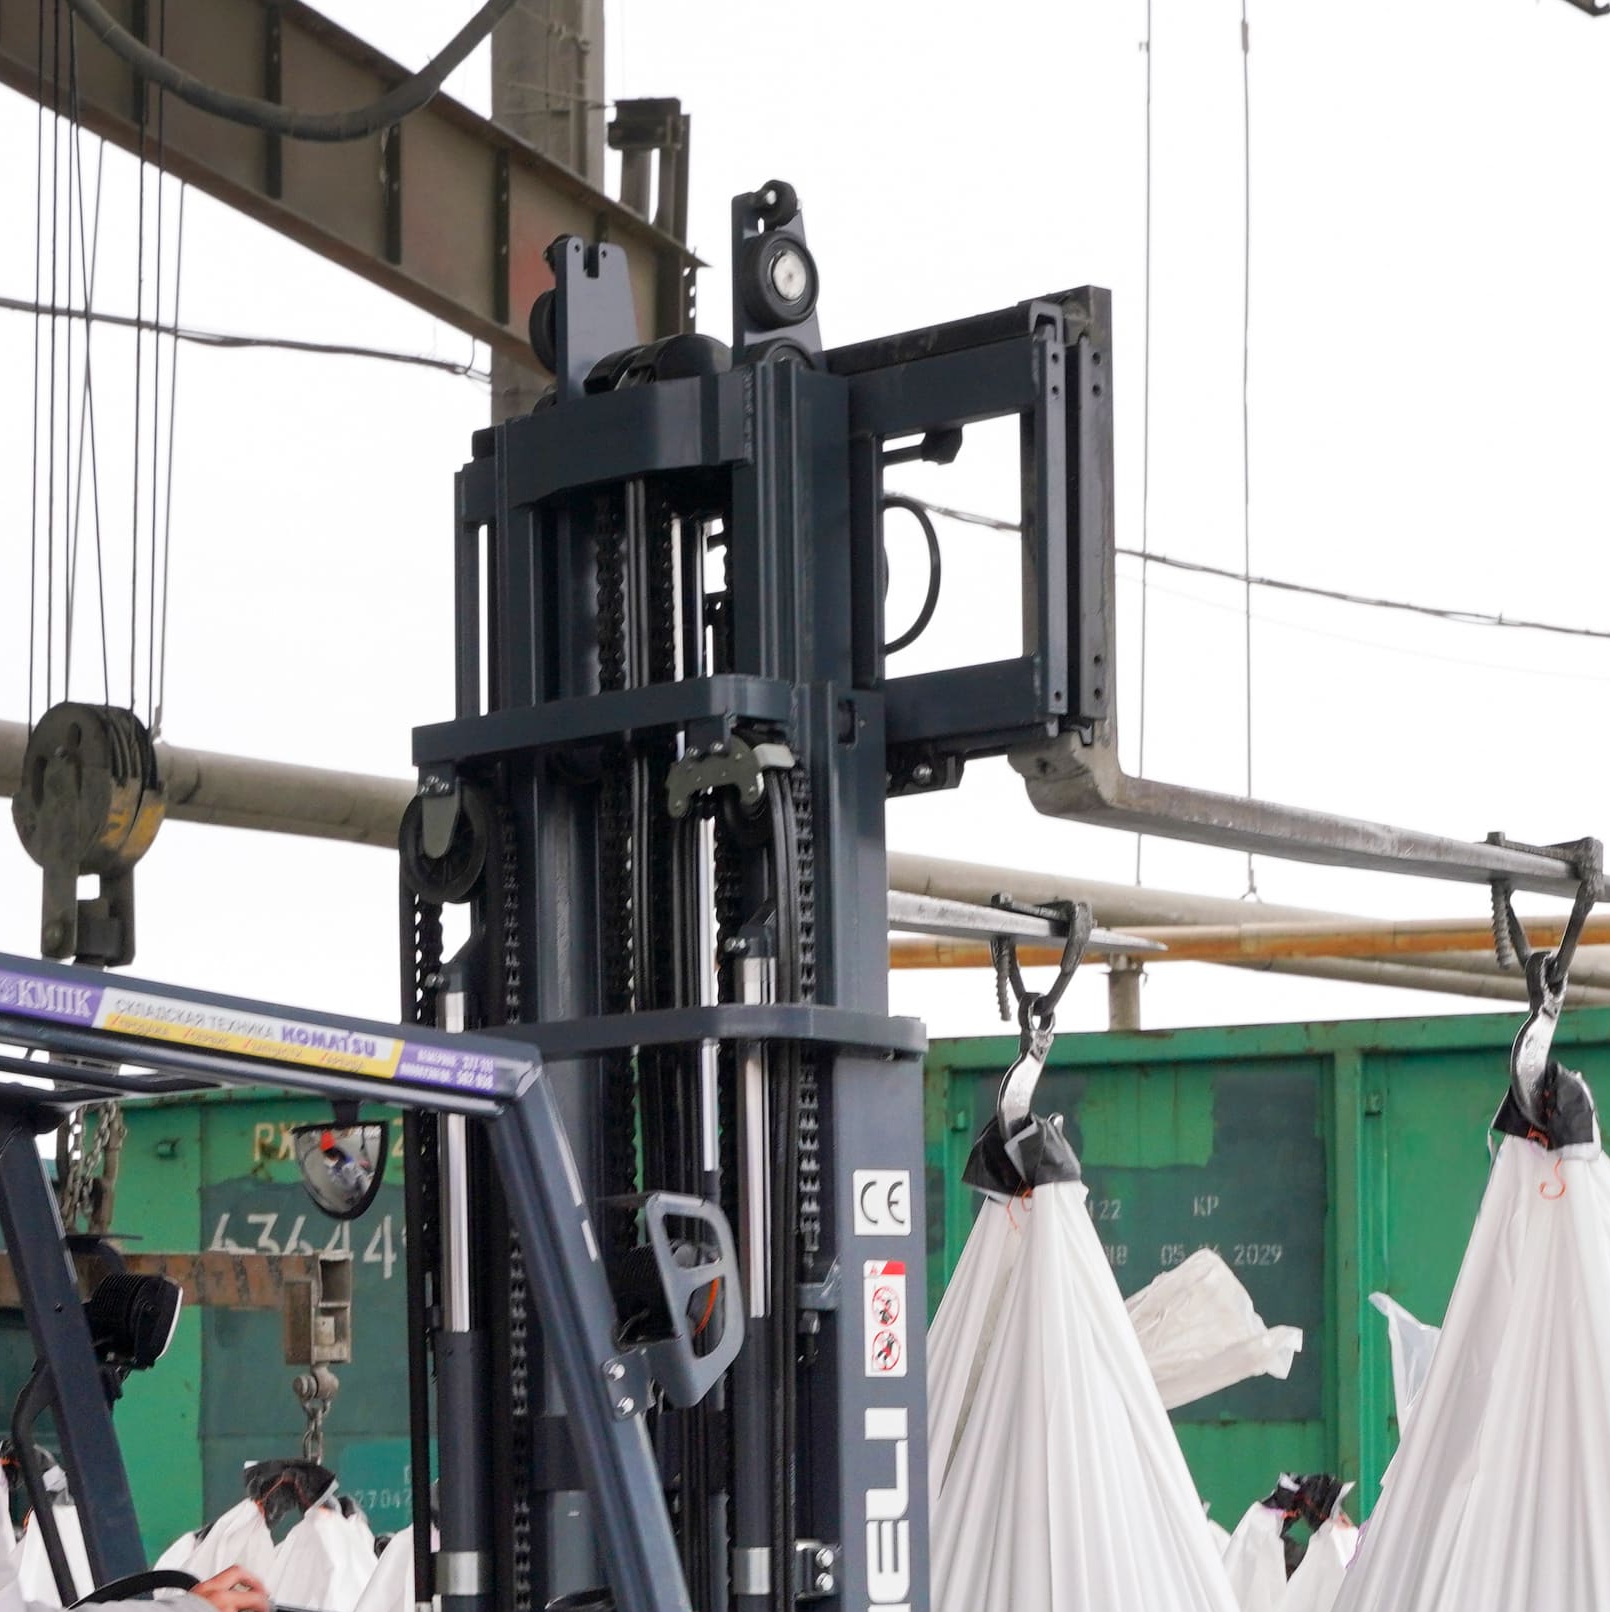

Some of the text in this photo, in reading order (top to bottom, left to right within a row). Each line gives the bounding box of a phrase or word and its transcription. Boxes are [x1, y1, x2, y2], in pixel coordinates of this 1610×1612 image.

[15, 978, 92, 1018] КМПК
[281, 1024, 376, 1058] KOMATSU
[860, 1179, 906, 1225] CE
[1233, 1244, 1283, 1266] 2029
